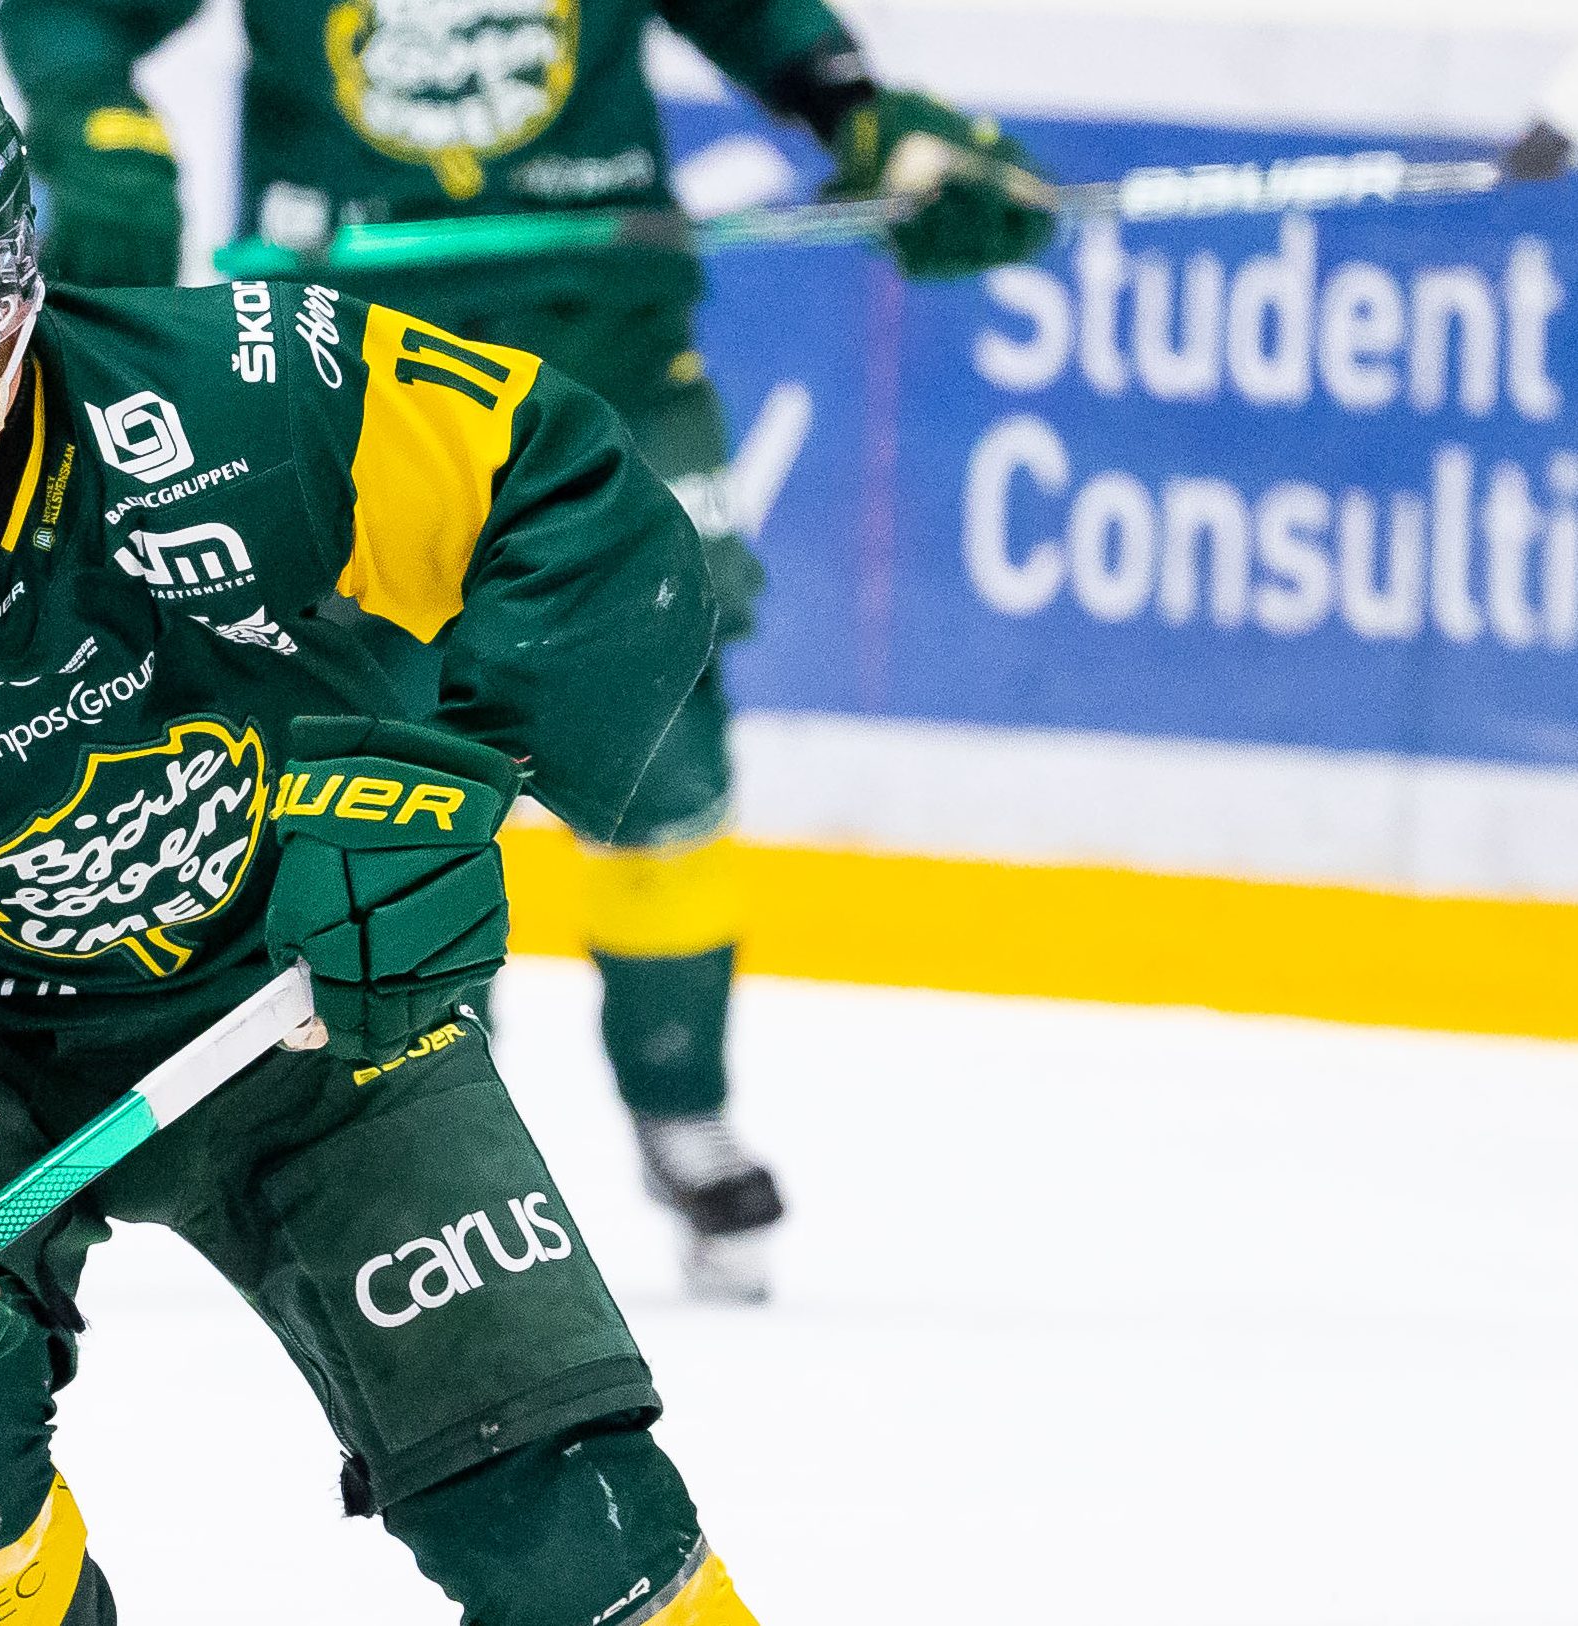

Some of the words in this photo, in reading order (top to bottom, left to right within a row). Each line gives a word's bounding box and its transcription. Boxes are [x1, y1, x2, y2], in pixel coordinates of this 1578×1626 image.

[395, 327, 511, 411] 11
[973, 213, 1558, 420] Student
[270, 773, 465, 831] UER
[354, 1191, 572, 1328] carus
